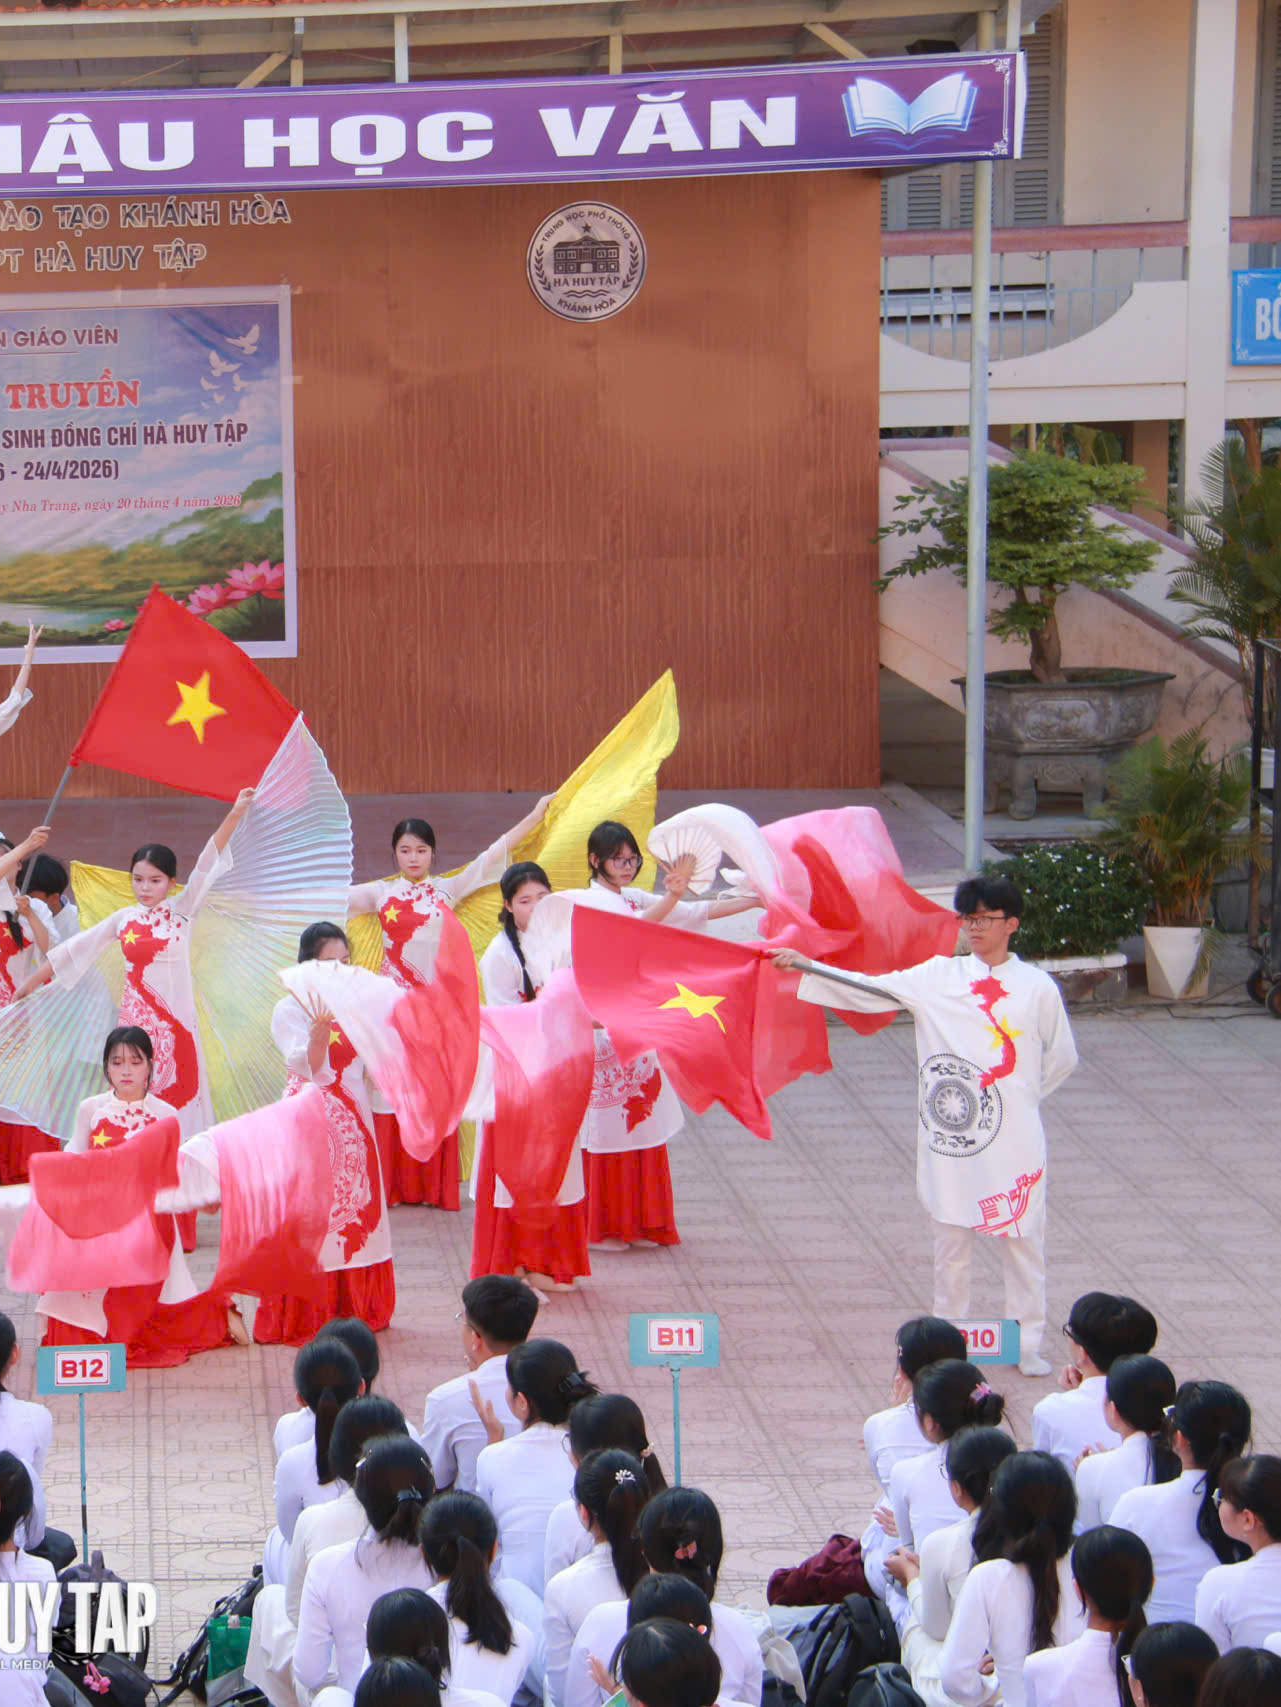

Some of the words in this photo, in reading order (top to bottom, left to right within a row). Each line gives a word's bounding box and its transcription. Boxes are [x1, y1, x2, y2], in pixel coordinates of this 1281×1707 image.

[243, 111, 494, 176] HỌC
[538, 91, 797, 158] VĂN
[53, 203, 109, 237] TẠO
[120, 196, 220, 228] KHÁNH
[229, 193, 292, 225] HÒA
[542, 219, 564, 242] TRUNG
[565, 211, 585, 222] HỌC
[587, 209, 607, 220] PHỔ
[607, 216, 631, 240] THÔNG
[34, 241, 76, 272] HÀ
[85, 245, 144, 271] HUY
[153, 237, 207, 272] TẬP
[553, 276, 569, 287] HÀ
[572, 277, 595, 286] HUY
[600, 275, 620, 287] TẬP
[557, 298, 592, 313] KHÁNH
[594, 297, 617, 312] HÒA
[13, 326, 67, 347] GIÁO
[73, 324, 118, 345] VIÊN
[5, 368, 140, 410] TRUYỀN
[2, 428, 45, 449] SINH
[51, 420, 101, 447] ĐỒNG
[107, 421, 137, 445] CHÍ
[143, 421, 167, 445] HÀ
[173, 423, 208, 444] HUY
[214, 419, 248, 447] TẬP
[23, 459, 119, 481] 24/4/2026)
[12, 499, 37, 512] Nha
[41, 499, 80, 514] Trang,
[84, 498, 114, 513] ngày
[118, 498, 132, 510] 20
[134, 496, 169, 510] tháng
[172, 497, 180, 507] 4
[183, 495, 210, 507] năm
[213, 494, 242, 507] 2026
[657, 1327, 694, 1347] B11
[61, 1358, 104, 1378] B12
